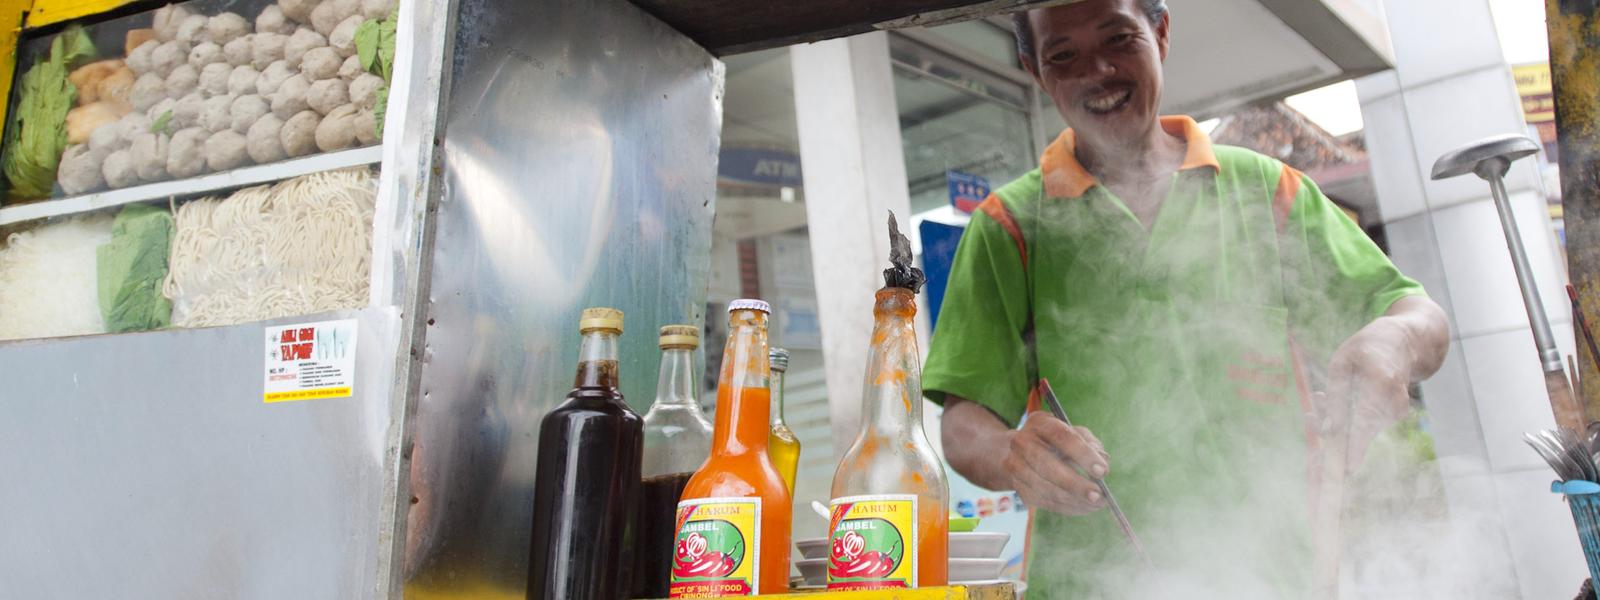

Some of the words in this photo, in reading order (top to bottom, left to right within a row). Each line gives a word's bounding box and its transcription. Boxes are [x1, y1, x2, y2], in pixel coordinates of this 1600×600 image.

[754, 159, 798, 176] ATM
[697, 506, 740, 515] HARUM
[853, 504, 897, 513] HARUM
[686, 585, 695, 593] OF
[720, 584, 742, 592] FOOD
